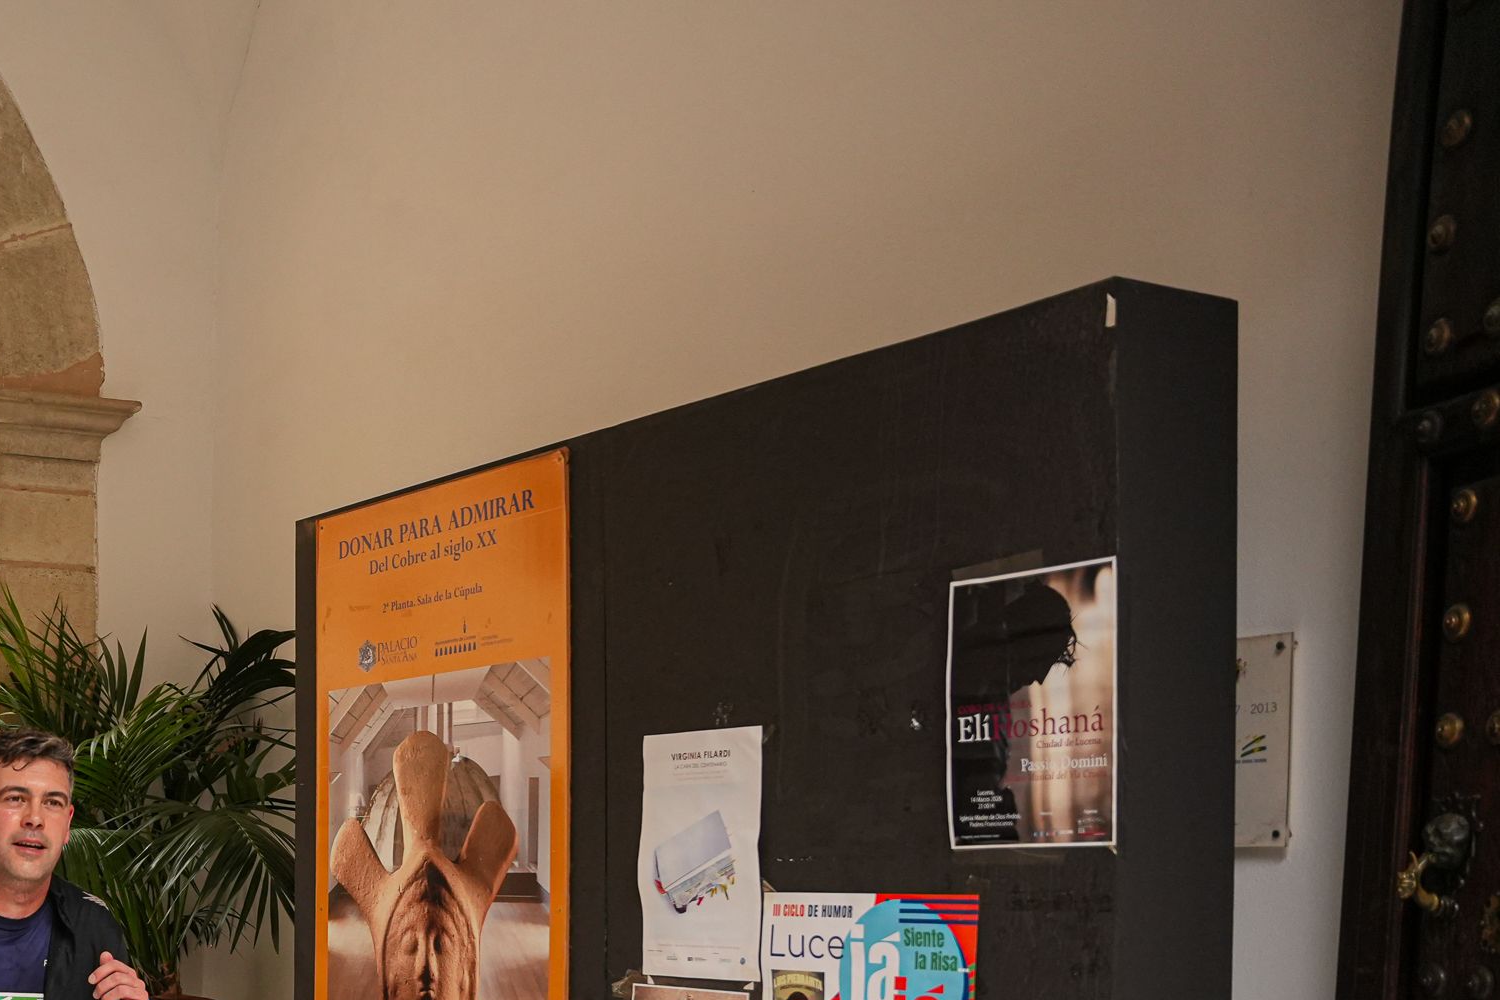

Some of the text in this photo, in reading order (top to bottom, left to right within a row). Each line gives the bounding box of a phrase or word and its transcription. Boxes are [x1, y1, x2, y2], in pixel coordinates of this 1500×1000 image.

[338, 489, 535, 560] DONAR PARA ADMIRAR
[369, 529, 498, 575] Del Cobre al siglo XX
[417, 595, 432, 607] Sala
[434, 591, 444, 602] de
[445, 589, 452, 600] la
[454, 583, 483, 599] Cúpula
[377, 636, 418, 662] PALACIO
[1250, 702, 1277, 714] 2013
[957, 705, 1104, 743] Elí Hoshaná
[1036, 737, 1102, 749] Ciudad de Lucena
[671, 749, 731, 760] VIRGINIA FILARDI
[772, 904, 853, 918] III CICLO DE HUMOR
[770, 924, 844, 959] Luce
[903, 927, 945, 948] Siente
[914, 951, 926, 970] la
